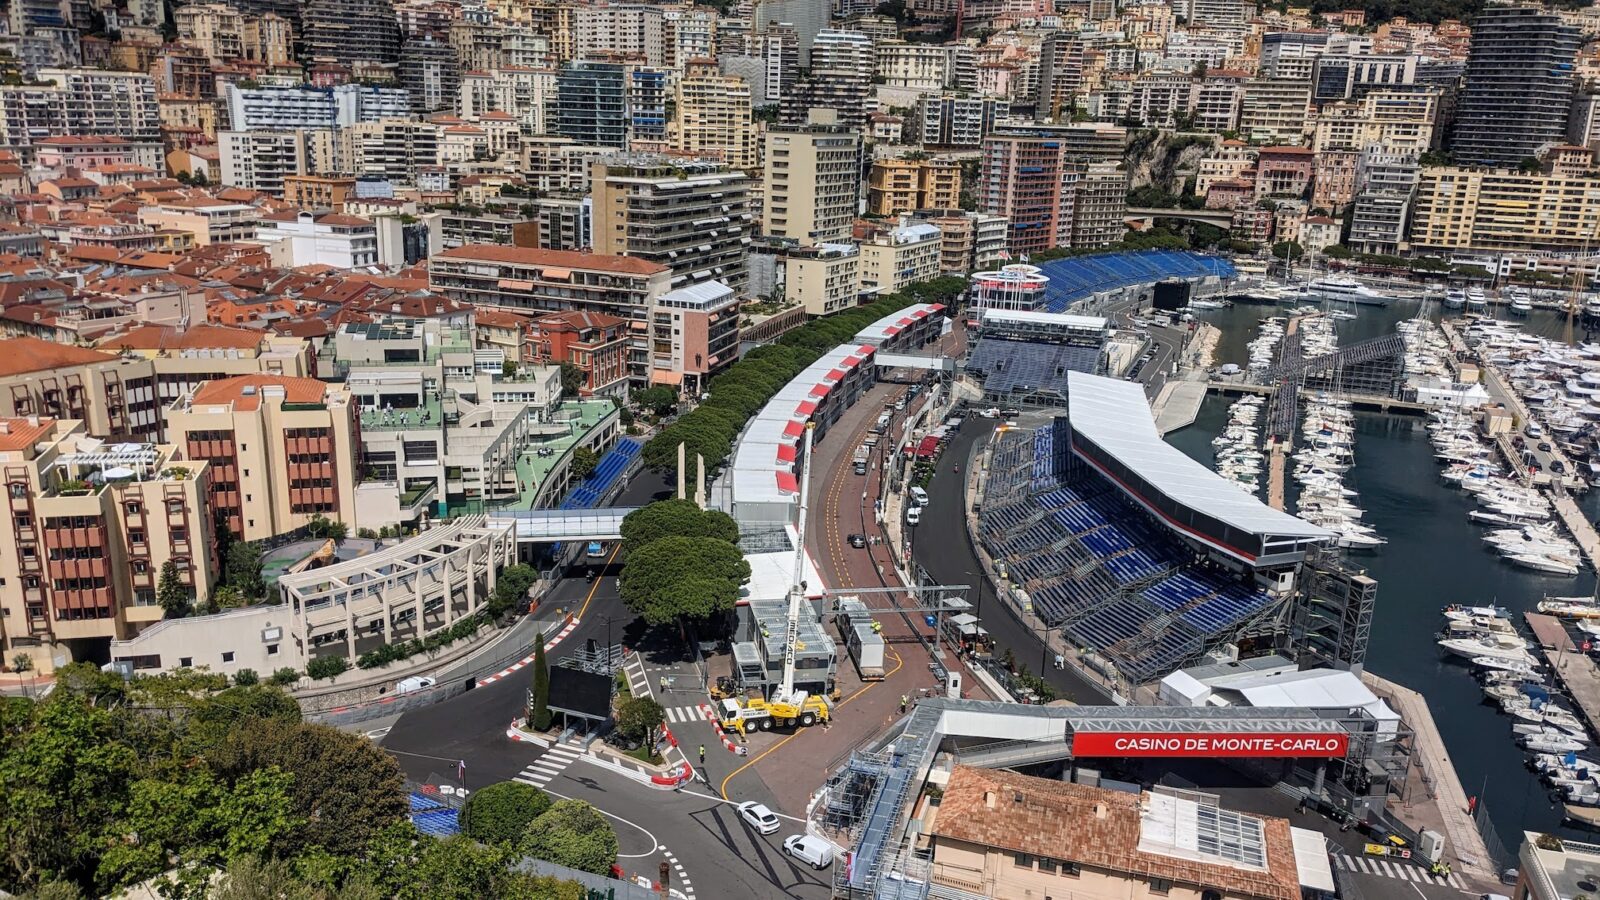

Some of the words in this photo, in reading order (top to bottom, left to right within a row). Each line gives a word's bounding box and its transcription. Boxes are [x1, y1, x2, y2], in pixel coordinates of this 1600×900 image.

[1115, 738, 1181, 751] CASINO
[1184, 739, 1209, 751] DE
[1212, 738, 1339, 751] MONTE-CARLO
